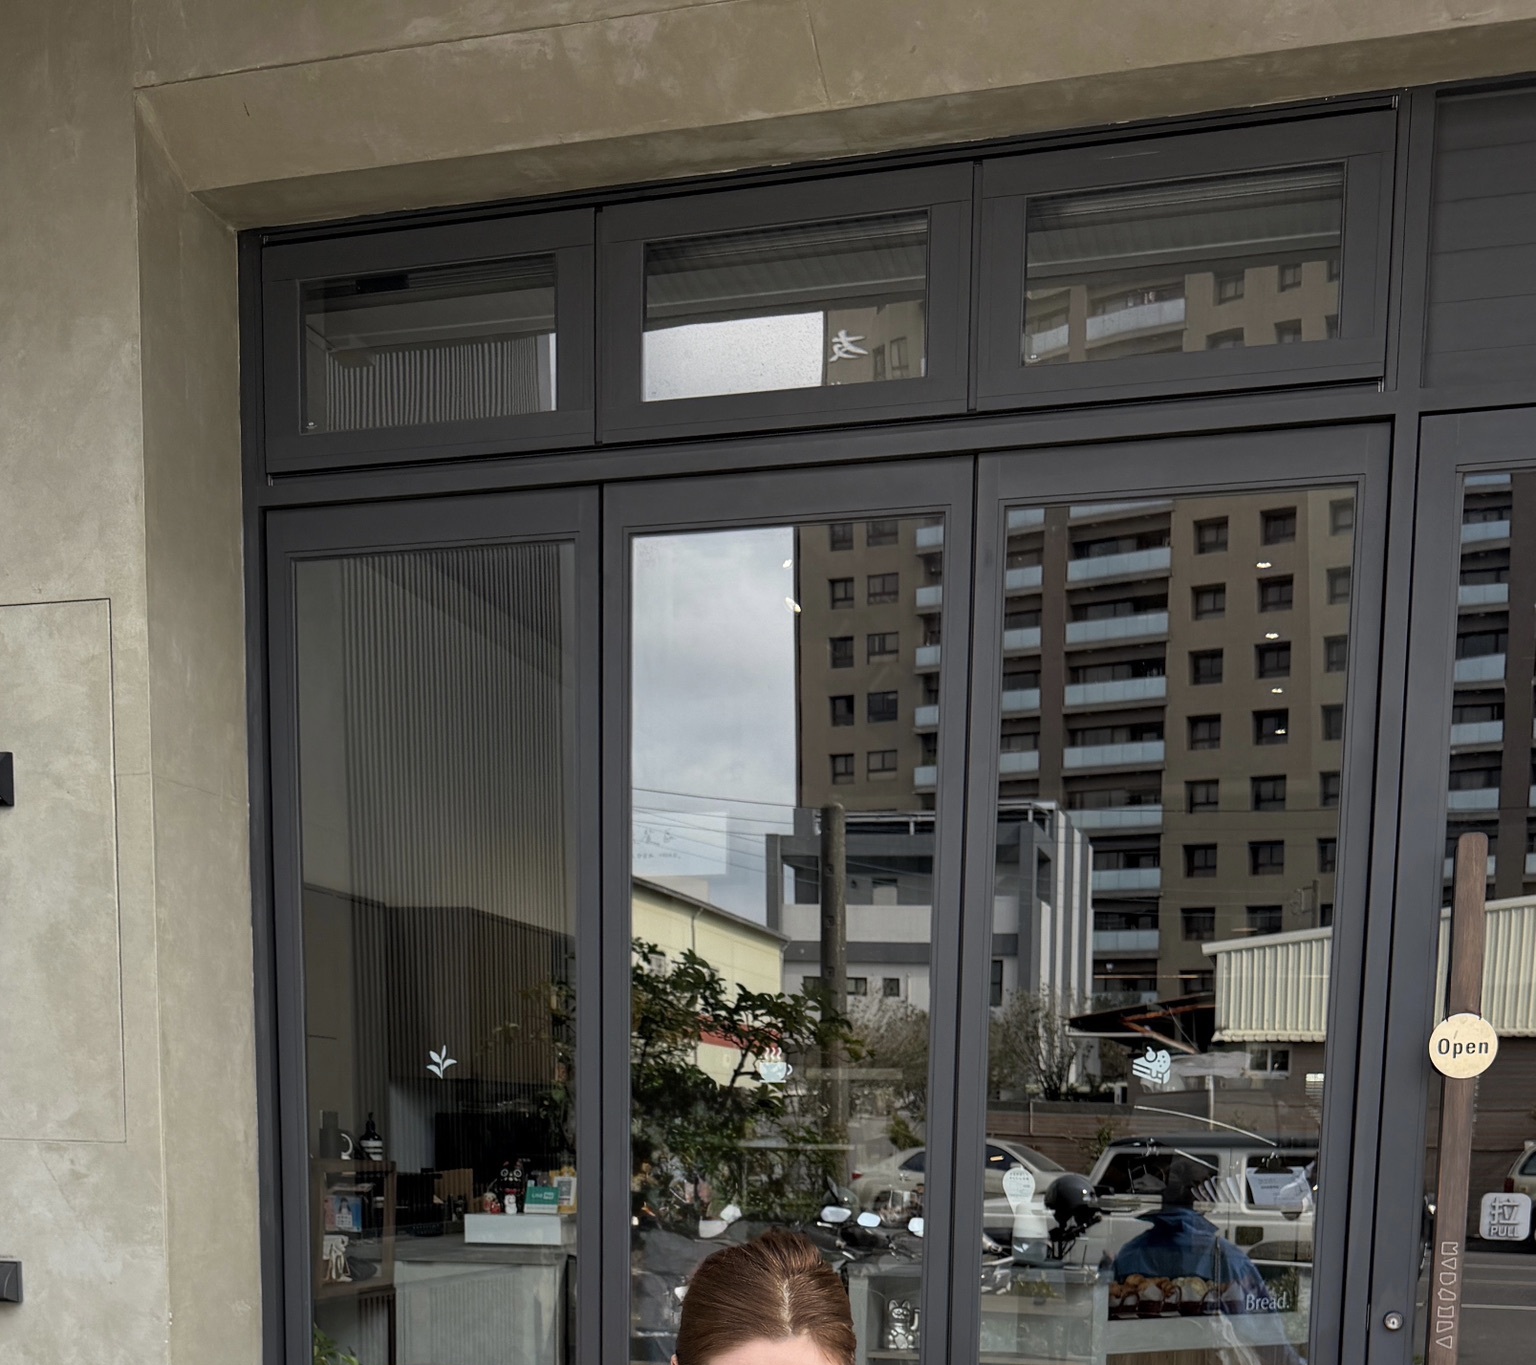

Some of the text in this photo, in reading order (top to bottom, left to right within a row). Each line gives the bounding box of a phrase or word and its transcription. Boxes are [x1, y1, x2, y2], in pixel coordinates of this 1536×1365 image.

[1438, 1038, 1489, 1059] Open
[1490, 1197, 1519, 1225] 拉
[1489, 1226, 1520, 1238] PULL
[1246, 1291, 1290, 1311] Bread.
